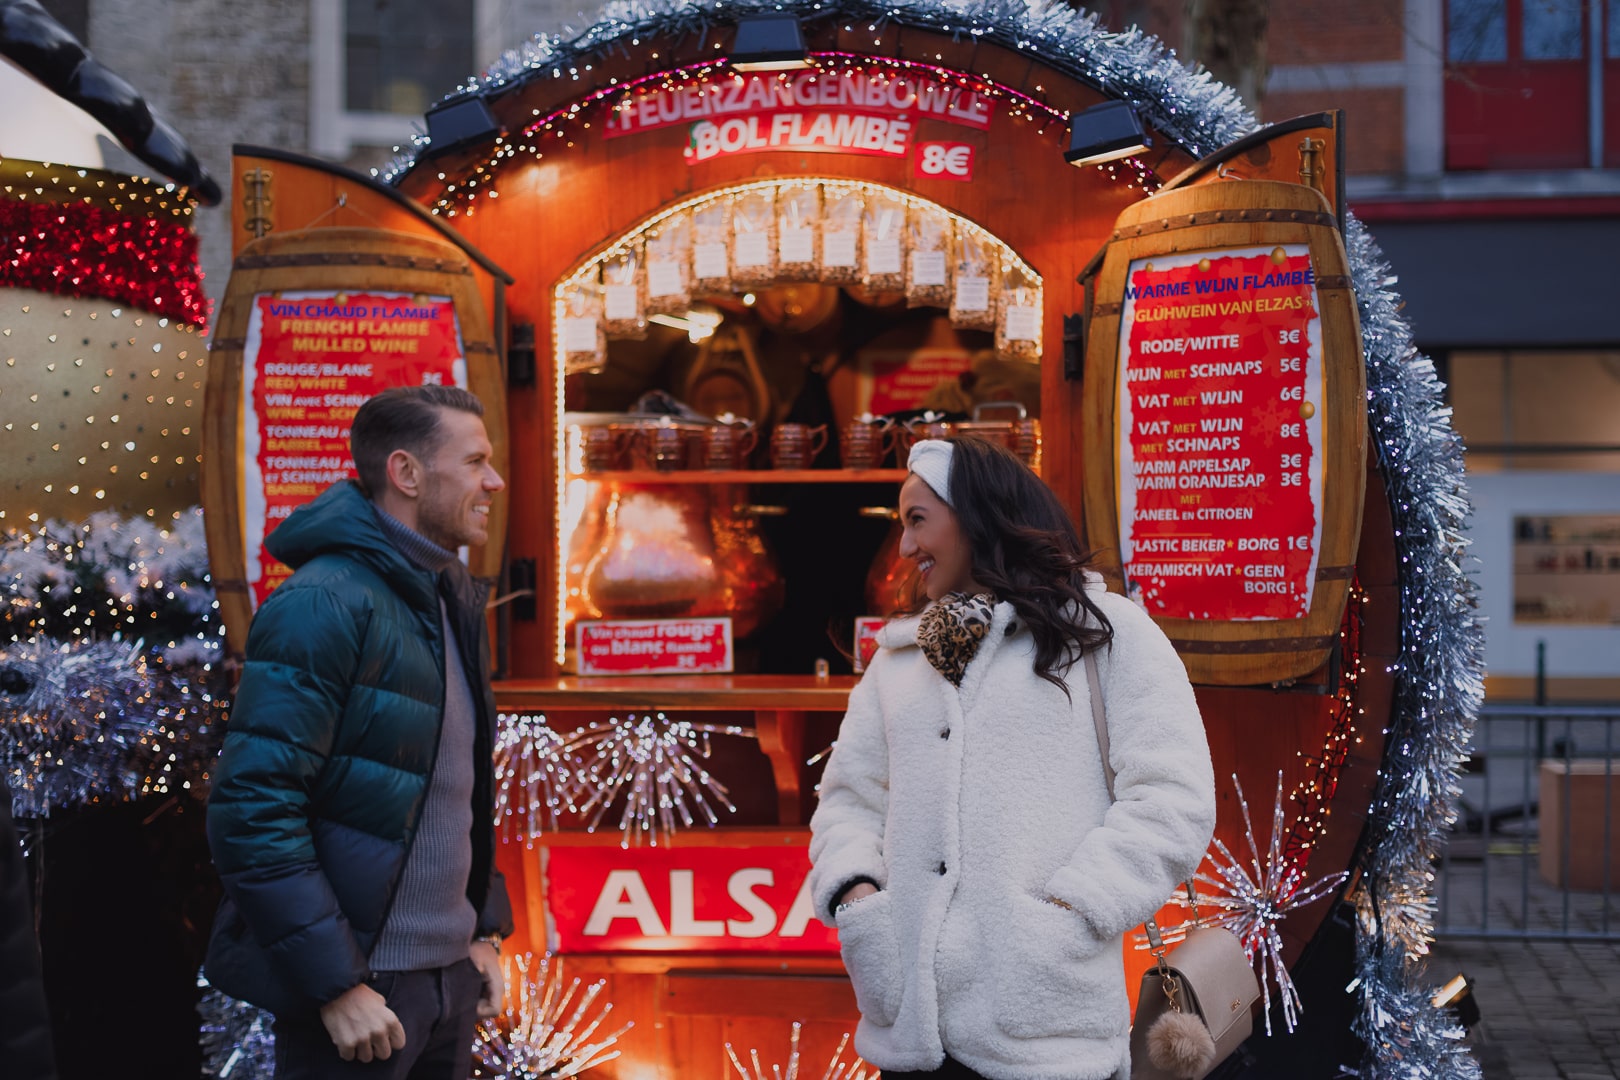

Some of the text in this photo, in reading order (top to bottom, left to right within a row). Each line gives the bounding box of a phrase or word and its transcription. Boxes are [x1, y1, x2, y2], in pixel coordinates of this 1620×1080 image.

[620, 72, 990, 130] FEUERZANGENBOWLE
[697, 113, 911, 161] BOL FLAMBÉ
[920, 144, 971, 176] 8€
[1125, 267, 1315, 300] WARME WIJN FLAMBÉ
[269, 304, 439, 319] VIN CHAUD FLAMBÉ
[1135, 303, 1217, 323] GLÜHWEIN
[1219, 301, 1252, 316] VAN
[1255, 296, 1302, 313] ELZAS
[280, 320, 429, 336] FRENCH FLAMBÉ
[292, 338, 418, 353] MULLED WINE
[1140, 329, 1300, 355] RODE/WITTE 3€
[264, 363, 373, 378] ROUGE/BLANC
[1128, 358, 1301, 382] WIJN MET SCHNAPS 5€
[265, 377, 346, 391] RED/WHITE
[265, 394, 292, 407] VIN
[1138, 386, 1302, 409] VAT MET WIJN 6€
[266, 407, 305, 420] WINE
[329, 408, 357, 420] SCH
[266, 425, 339, 438] TONNEAU
[1138, 417, 1301, 439] VAT MET WIJN 8€
[1141, 436, 1240, 454] MET SCHNAPS
[266, 457, 341, 470] TONNEAU
[1178, 457, 1251, 474] APPELSAP
[1280, 454, 1302, 468] 3€
[1178, 473, 1266, 489] ORANJESAP
[1280, 472, 1302, 487] 3€
[1180, 495, 1201, 505] MET
[1133, 508, 1253, 521] KANEEL EN CITROEN
[1181, 539, 1225, 552] BEKER
[1238, 538, 1279, 551] BORG
[1287, 536, 1309, 550] 1€
[1128, 564, 1285, 578] KERAMISCH VAT GEEN
[1244, 581, 1287, 594] BORG
[657, 625, 714, 640] rouge
[611, 640, 664, 654] blanc
